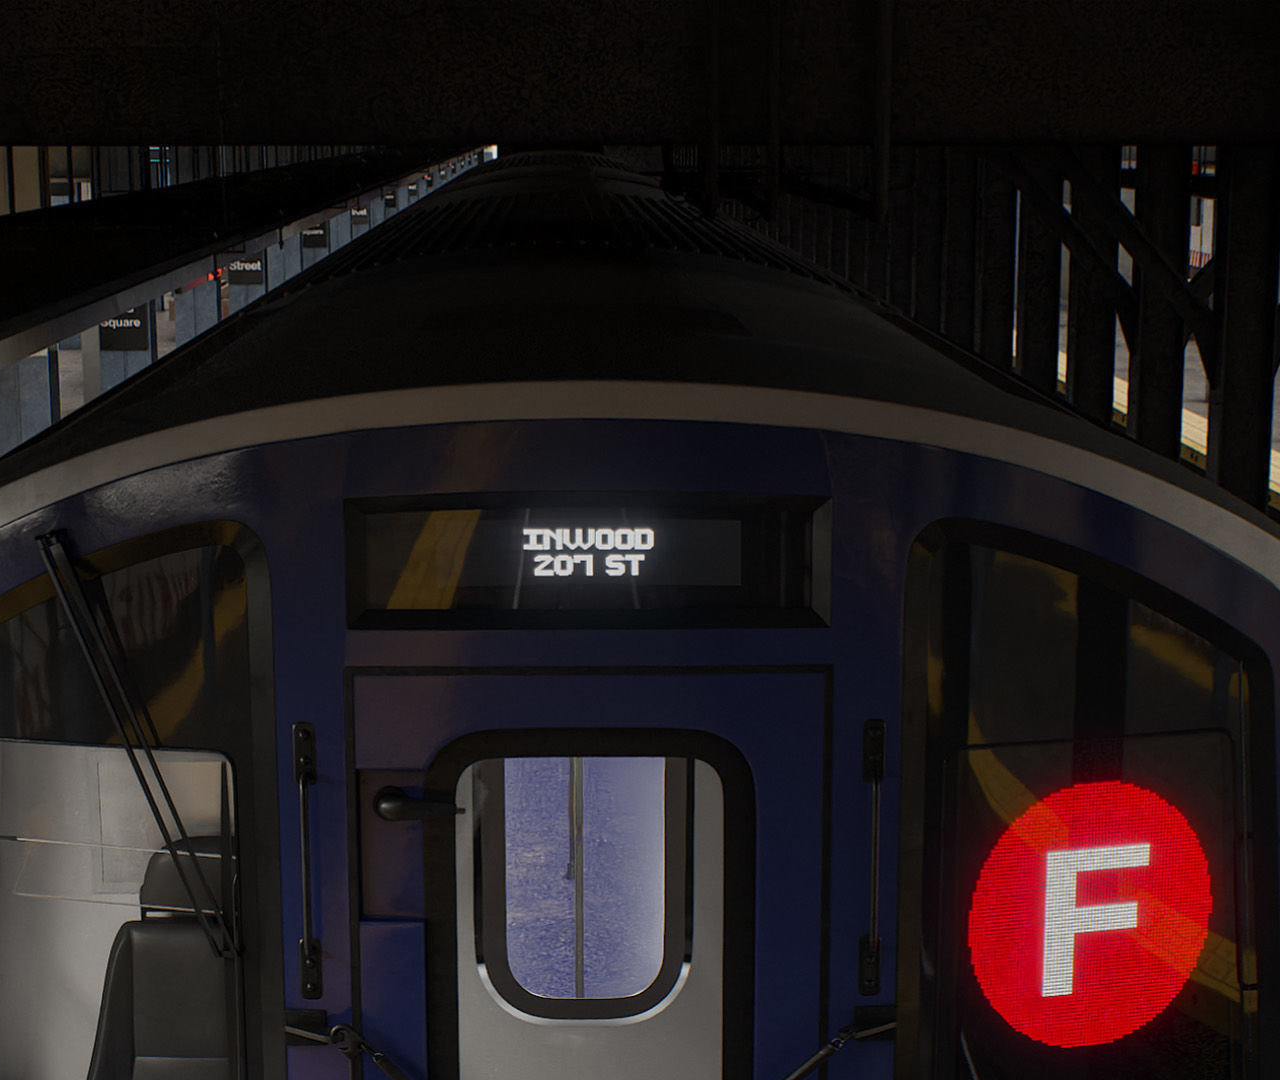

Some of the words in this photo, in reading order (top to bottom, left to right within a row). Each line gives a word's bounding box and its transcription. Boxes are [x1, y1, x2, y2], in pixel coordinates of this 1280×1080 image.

[522, 528, 655, 551] INWOOD
[533, 554, 594, 577] 207
[605, 554, 646, 577] ST
[1041, 842, 1151, 998] F
